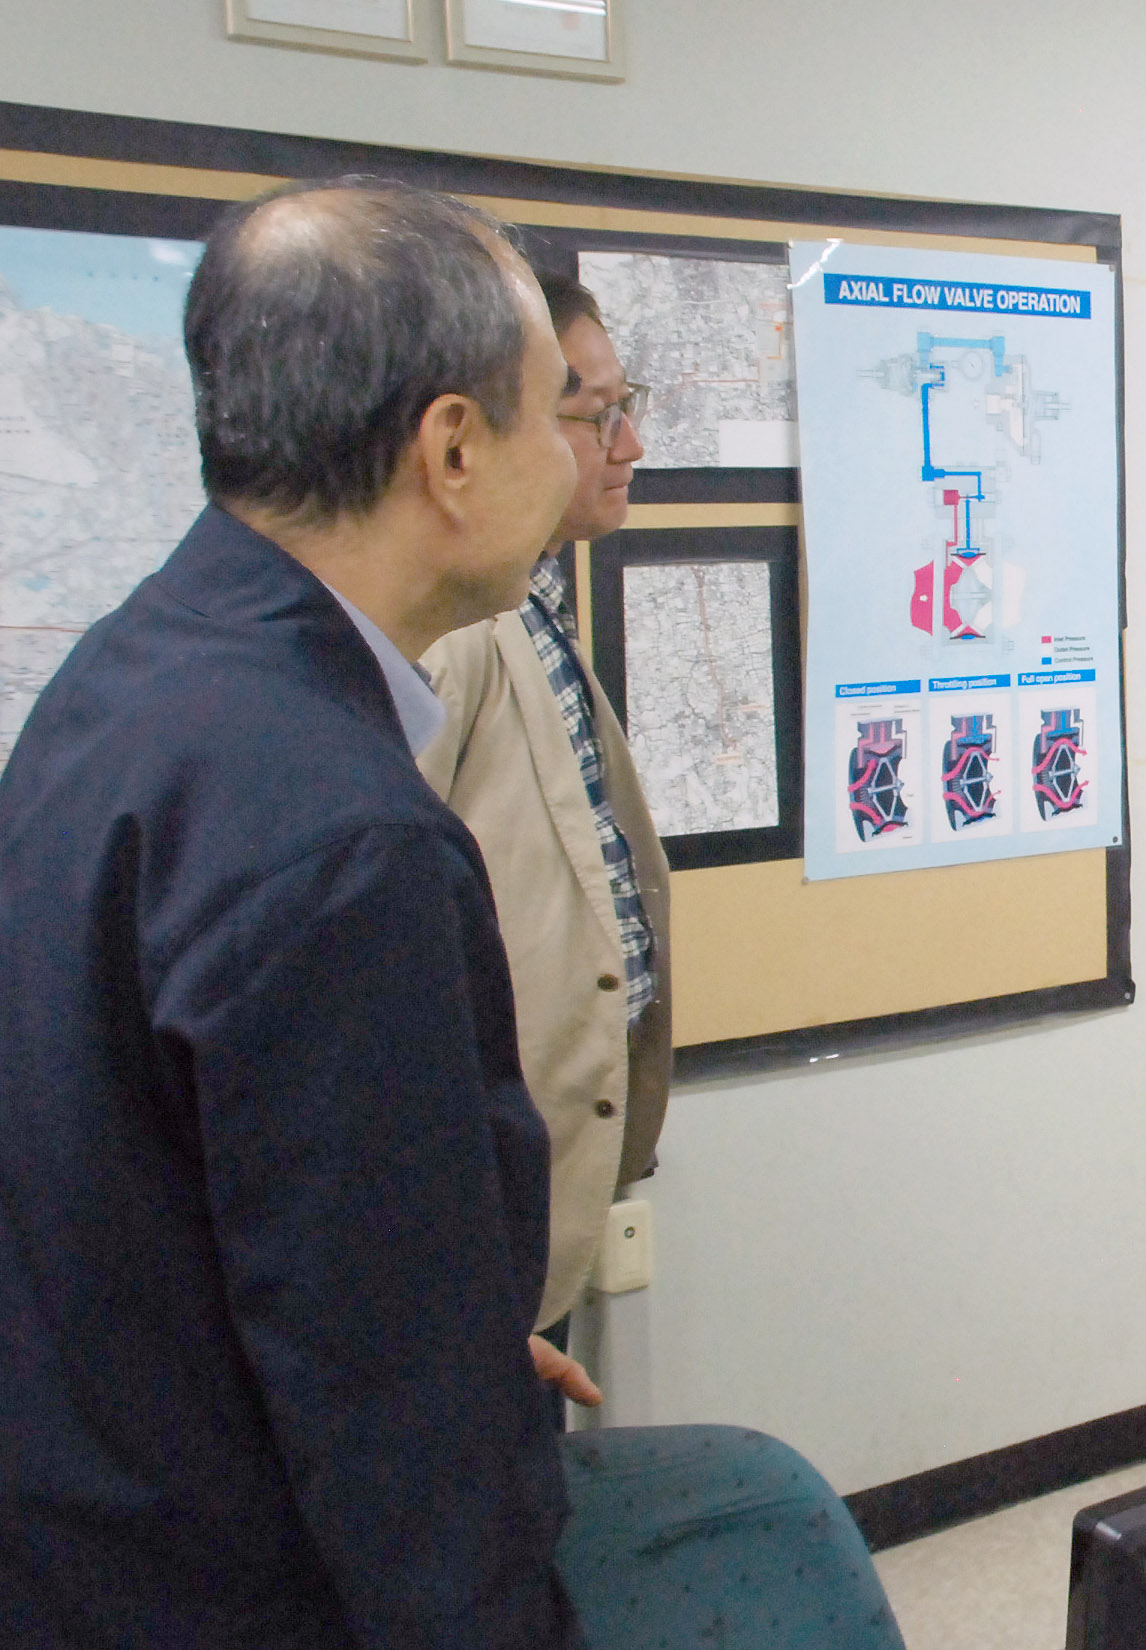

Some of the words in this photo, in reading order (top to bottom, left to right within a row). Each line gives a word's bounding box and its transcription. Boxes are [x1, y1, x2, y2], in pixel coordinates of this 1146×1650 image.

[838, 280, 888, 302] AXIAL
[893, 283, 942, 305] FLOW
[945, 286, 994, 309] VALVE
[997, 290, 1081, 314] OPERATION
[932, 679, 967, 690] Throttling
[968, 677, 997, 689] position
[1021, 673, 1035, 684] Full
[1036, 674, 1053, 685] open
[1053, 671, 1082, 683] position
[839, 685, 866, 696] Closed
[867, 683, 897, 696] position
